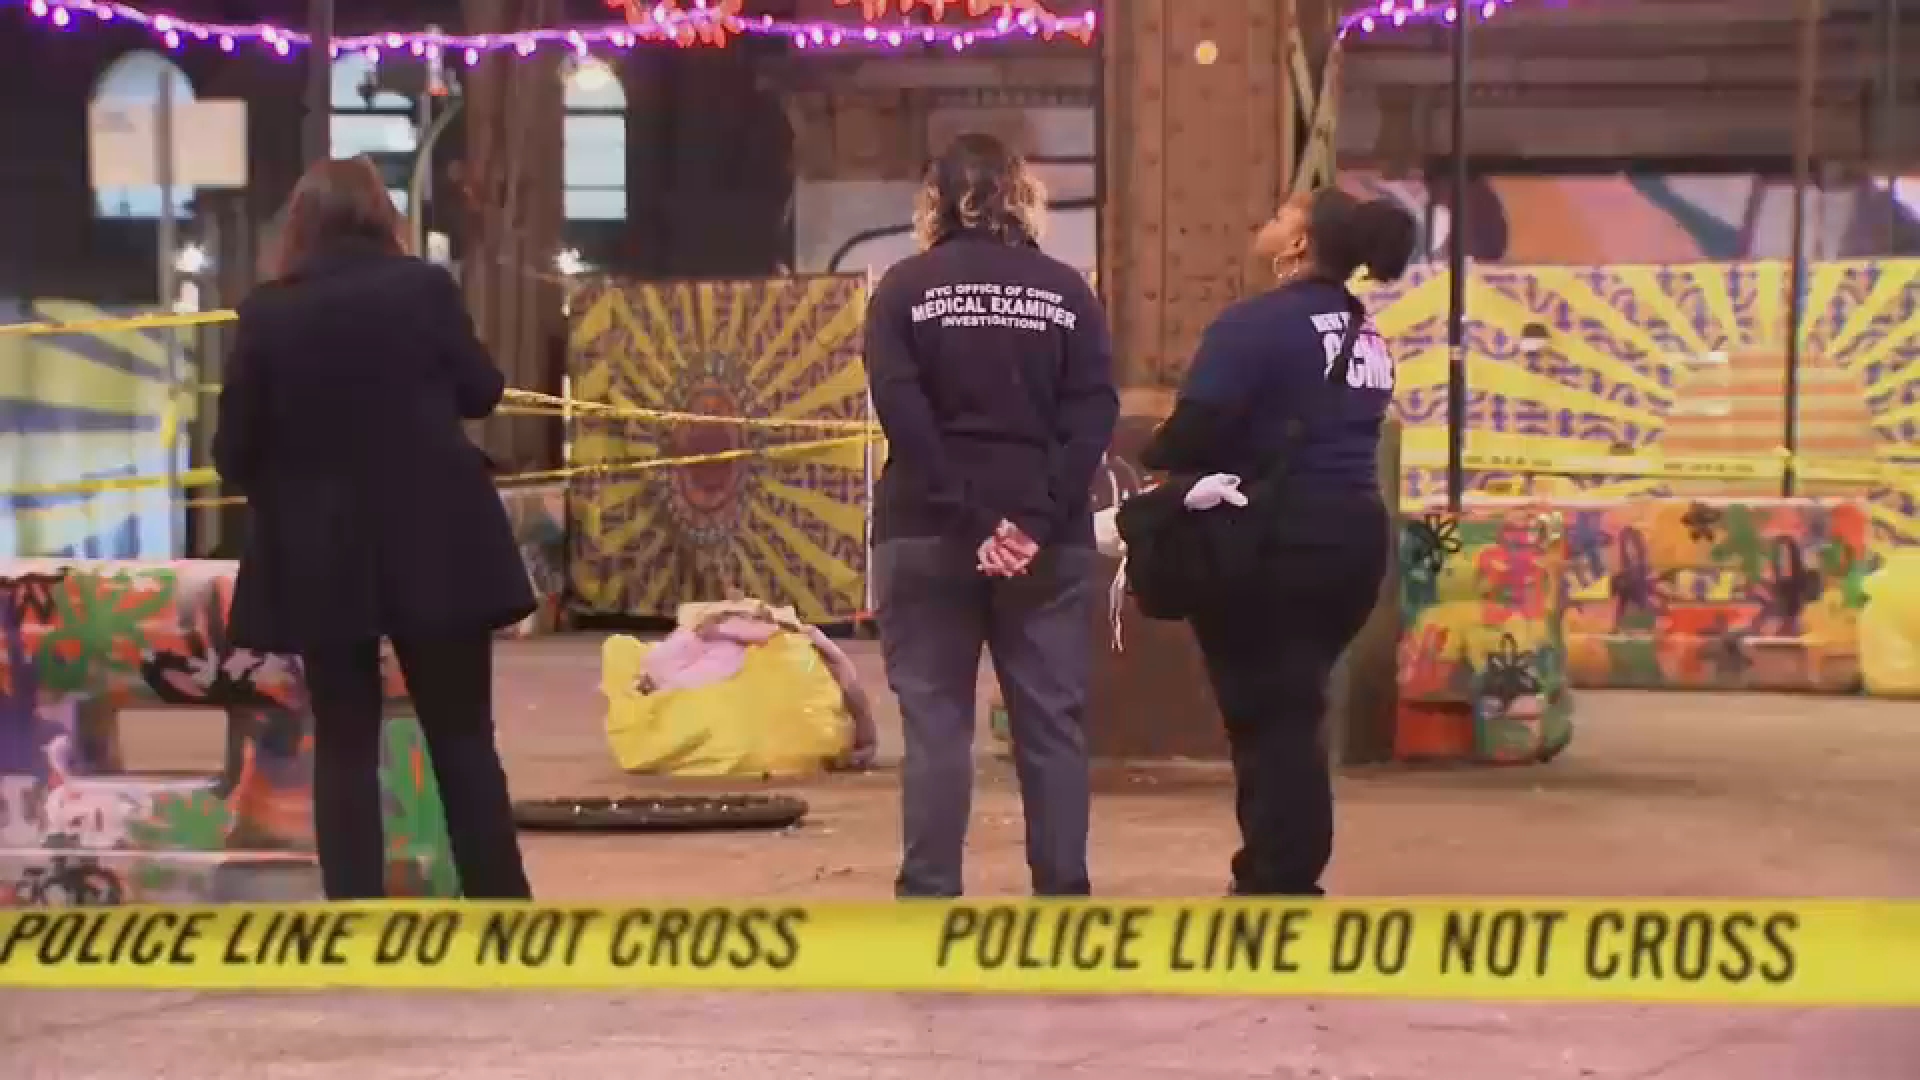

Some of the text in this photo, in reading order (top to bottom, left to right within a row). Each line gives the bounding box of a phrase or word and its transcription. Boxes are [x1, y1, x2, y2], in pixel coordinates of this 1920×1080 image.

[925, 283, 1063, 303] NYC OFFICE OF CHIEF
[911, 295, 1077, 331] MEDICAL EXAMINER
[941, 315, 1047, 331] INVESTIGATIONS
[0, 906, 811, 970] POLICE LINE DO NOT CROSS
[936, 906, 1800, 984] POLICE LINE DO NOT CROSS
